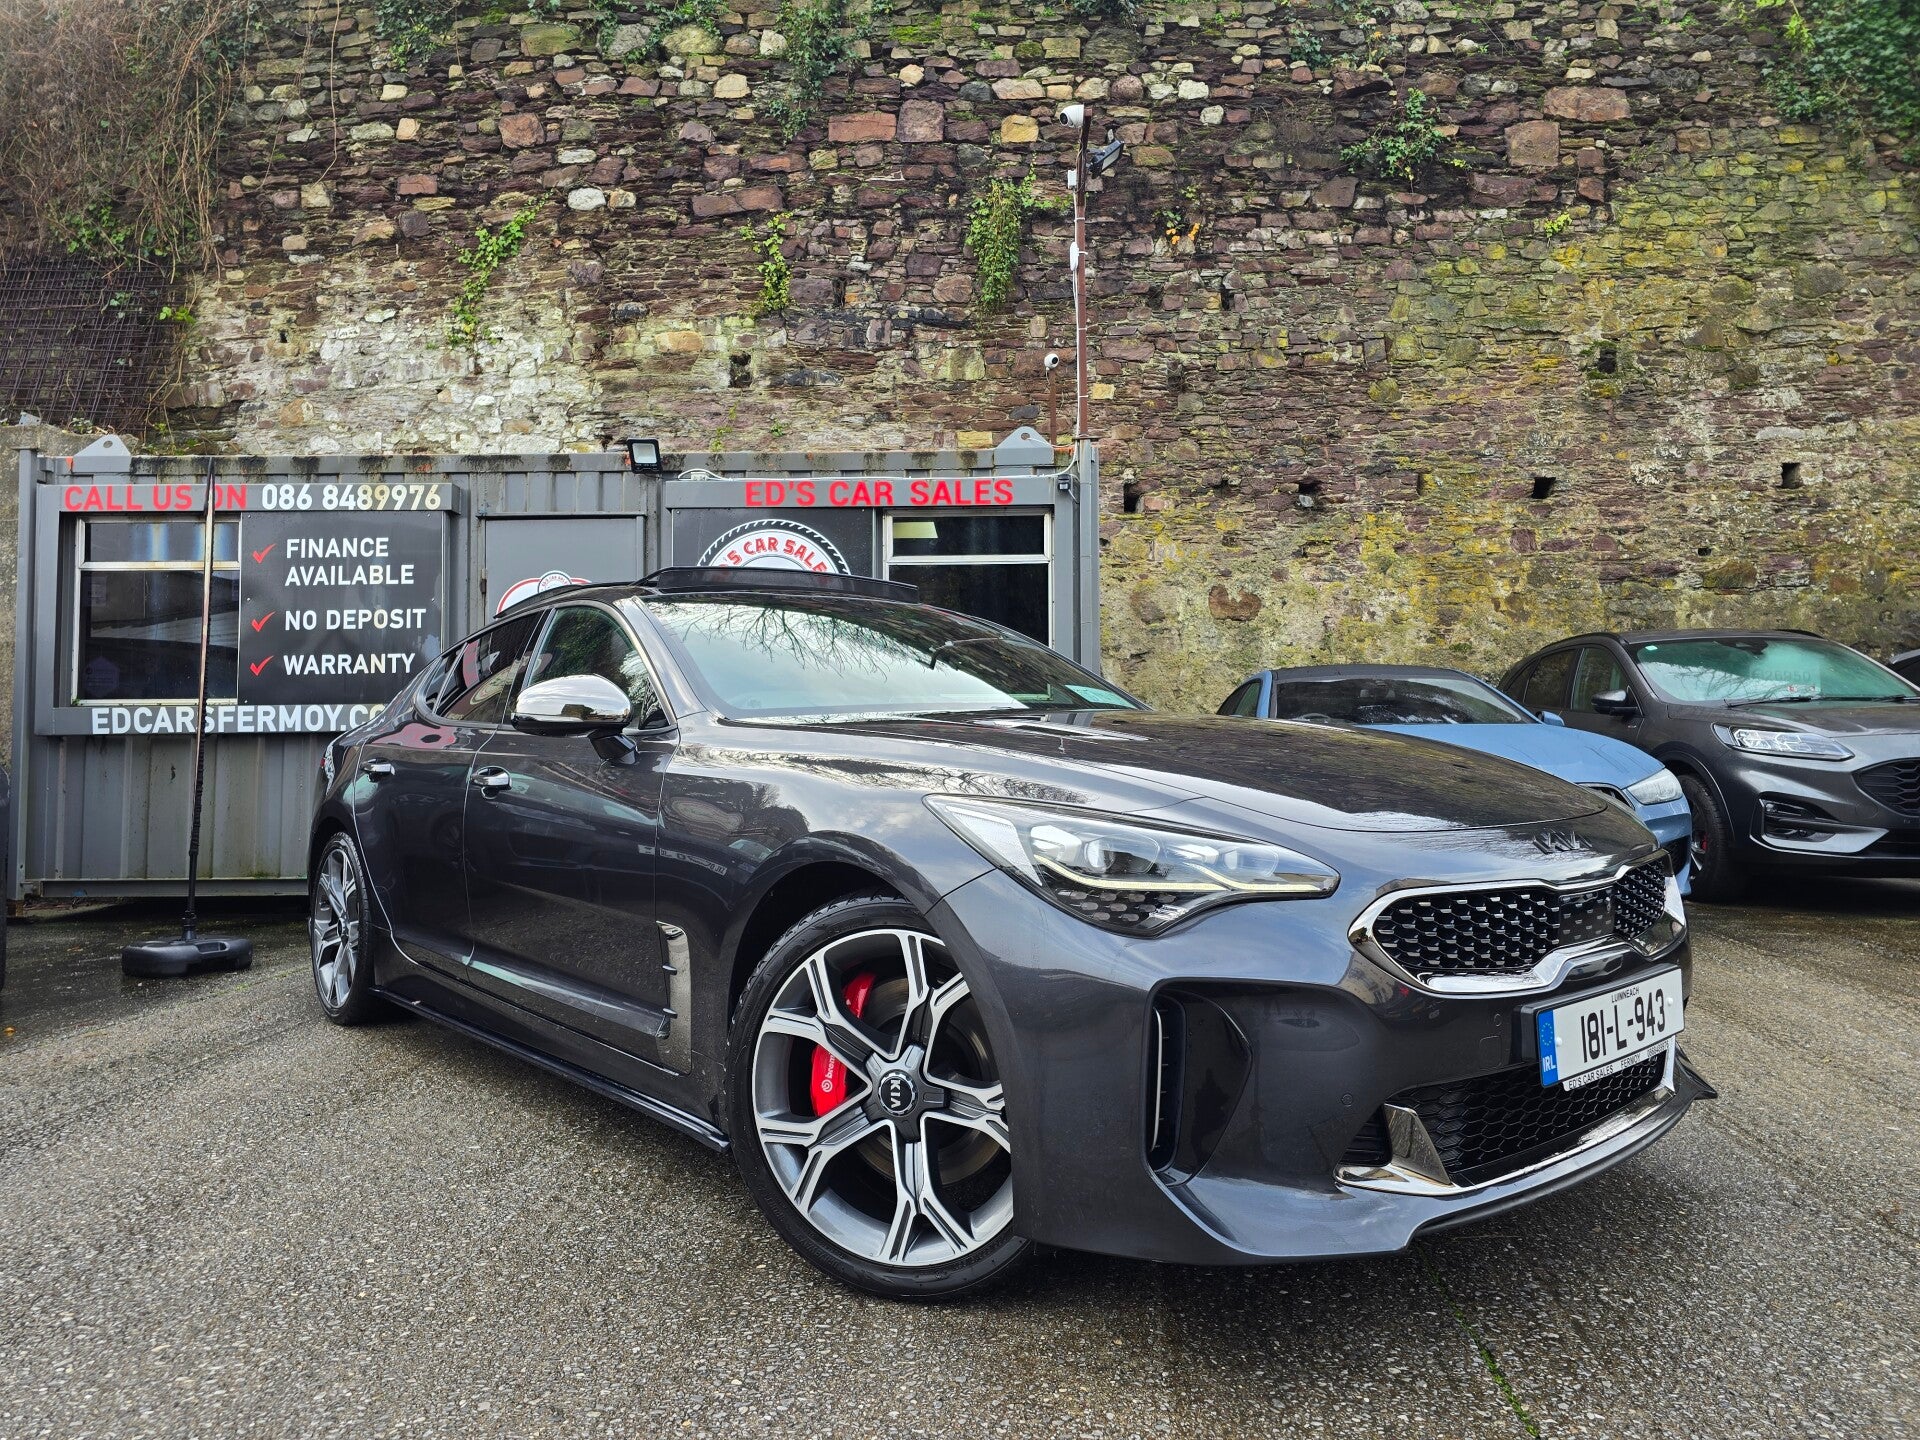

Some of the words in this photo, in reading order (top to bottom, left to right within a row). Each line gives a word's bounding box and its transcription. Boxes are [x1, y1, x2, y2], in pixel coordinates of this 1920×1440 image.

[64, 486, 143, 512] CALL
[153, 485, 193, 511] US
[261, 485, 313, 511] 086
[322, 484, 442, 511] 8489976
[745, 481, 816, 507] ED'S
[829, 480, 894, 506] CAR
[910, 479, 1014, 505] SALES
[285, 537, 389, 559] FINANCE
[743, 537, 779, 556] CAR
[783, 539, 828, 573] SALE
[284, 564, 415, 587] AVAILABLE
[284, 611, 317, 630] NO
[326, 608, 427, 630] DEPOSIT
[283, 652, 415, 676] WARRANTY
[1581, 988, 1665, 1062] 181-L-943
[1542, 1055, 1556, 1072] IRL
[1582, 1071, 1597, 1084] CAR
[1596, 1064, 1614, 1081] SALES
[890, 1079, 902, 1109] KIA
